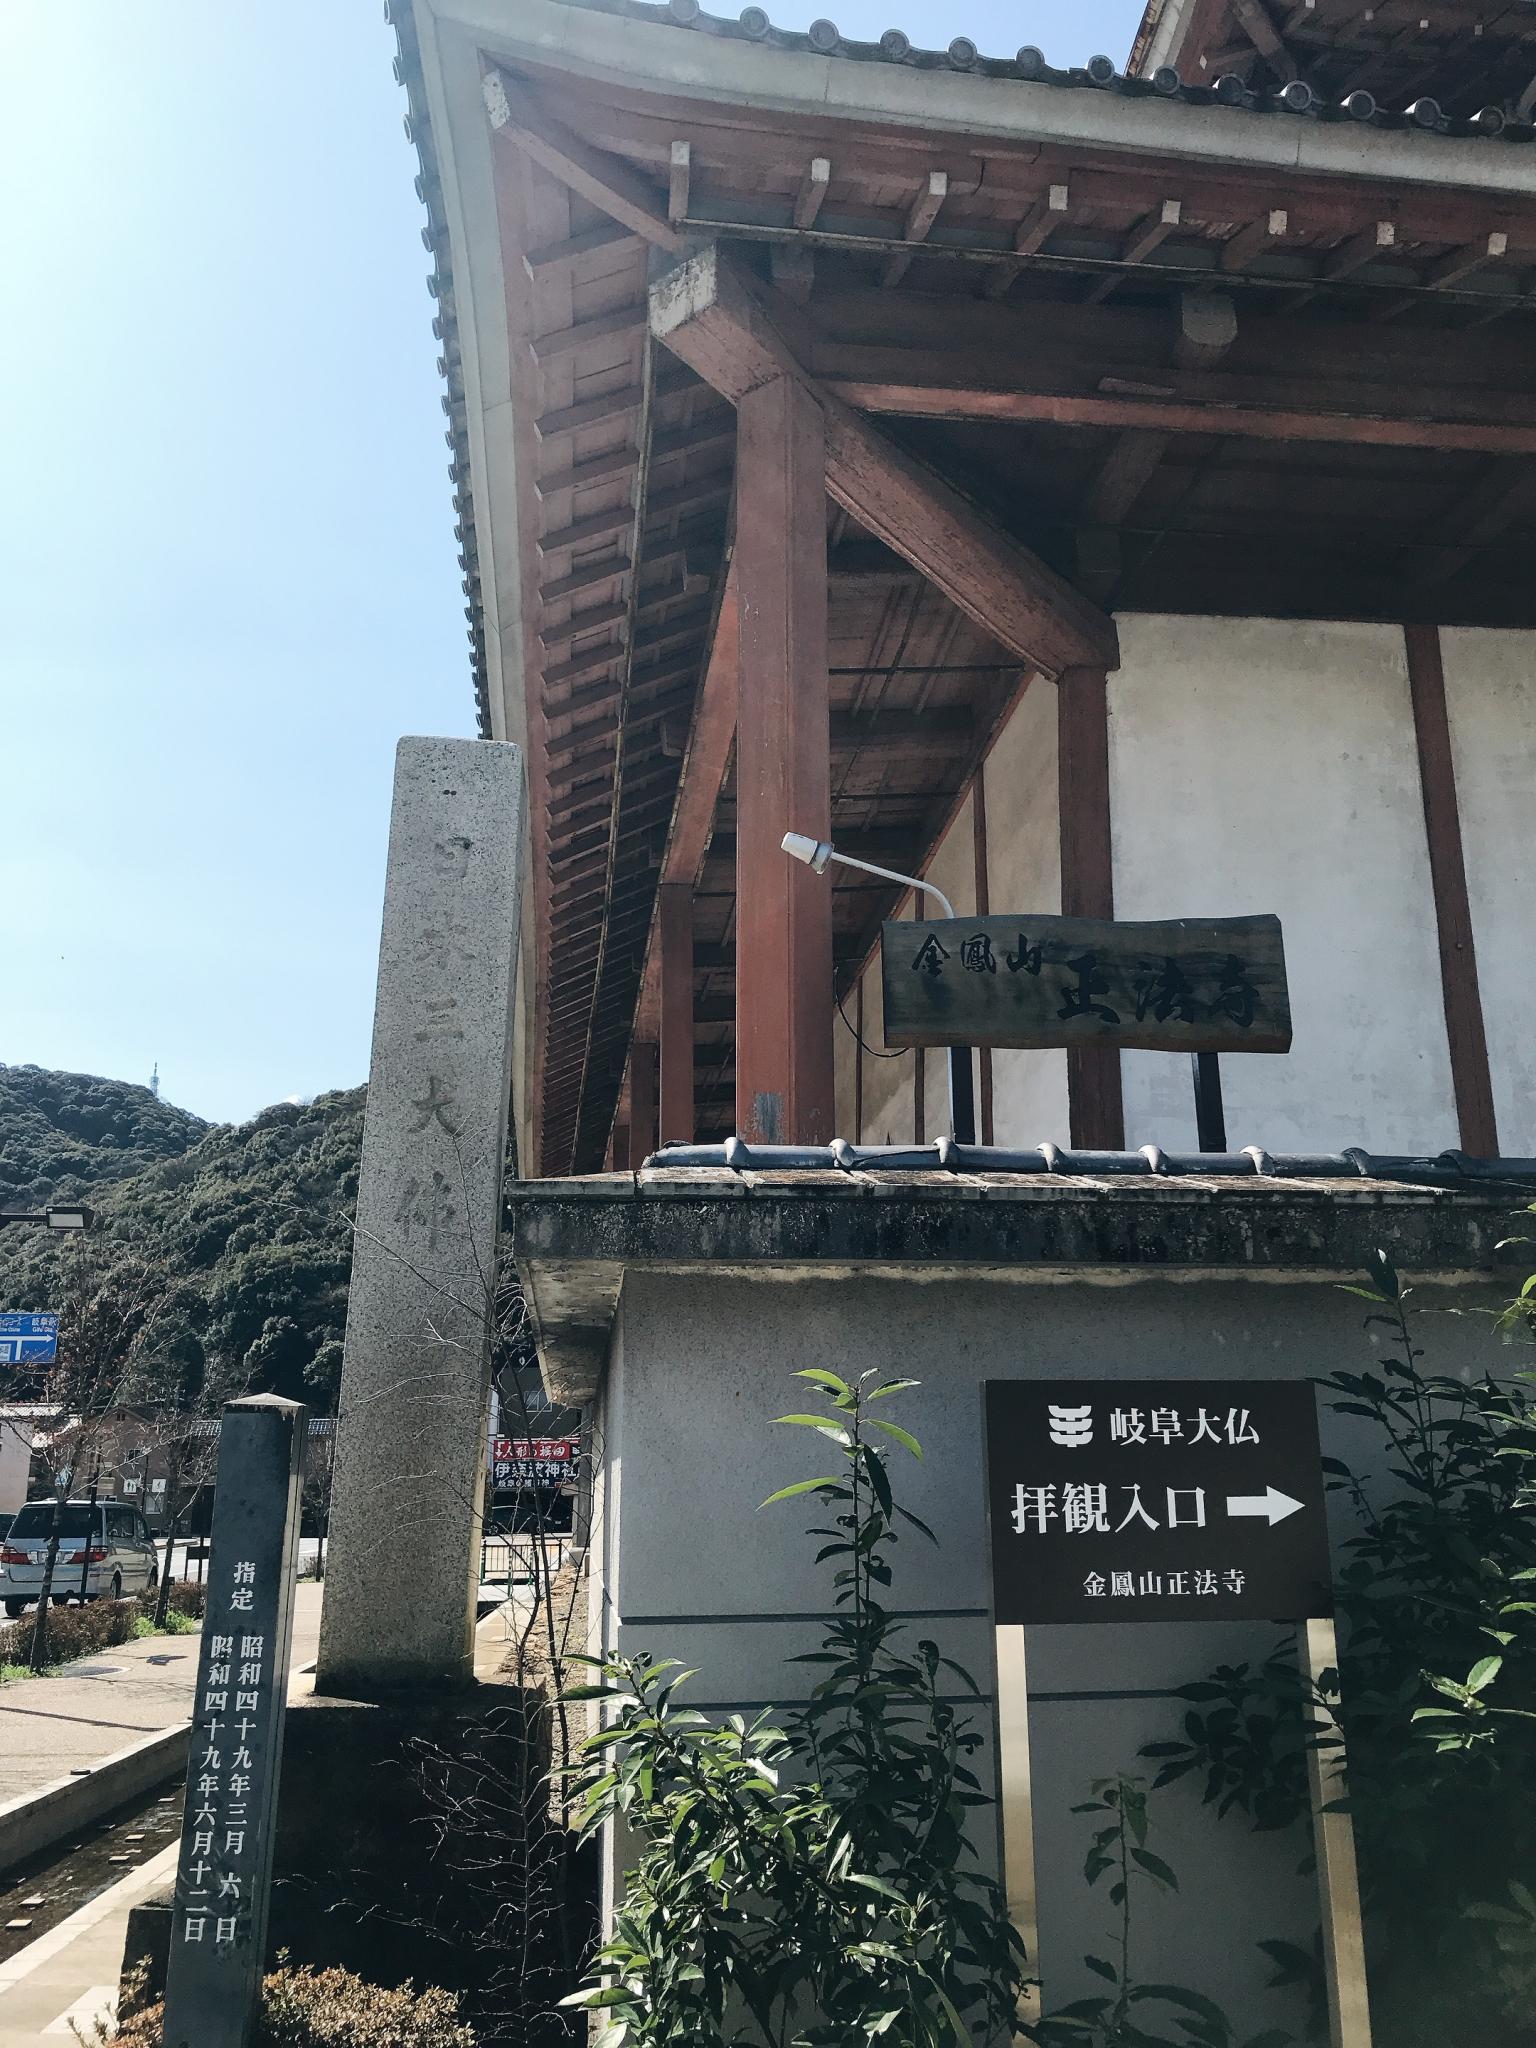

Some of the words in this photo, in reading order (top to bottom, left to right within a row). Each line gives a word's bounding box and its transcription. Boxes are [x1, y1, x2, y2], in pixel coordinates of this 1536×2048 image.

[911, 933, 1042, 977] 金鳳山
[1110, 1407, 1260, 1446] 岐阜大仏
[1010, 1482, 1206, 1534] 拝観入口
[228, 1561, 256, 1611] 指定
[1083, 1568, 1246, 1598] 金鳳山正法寺
[184, 1635, 233, 1943] 昭和四十九年六月十二日
